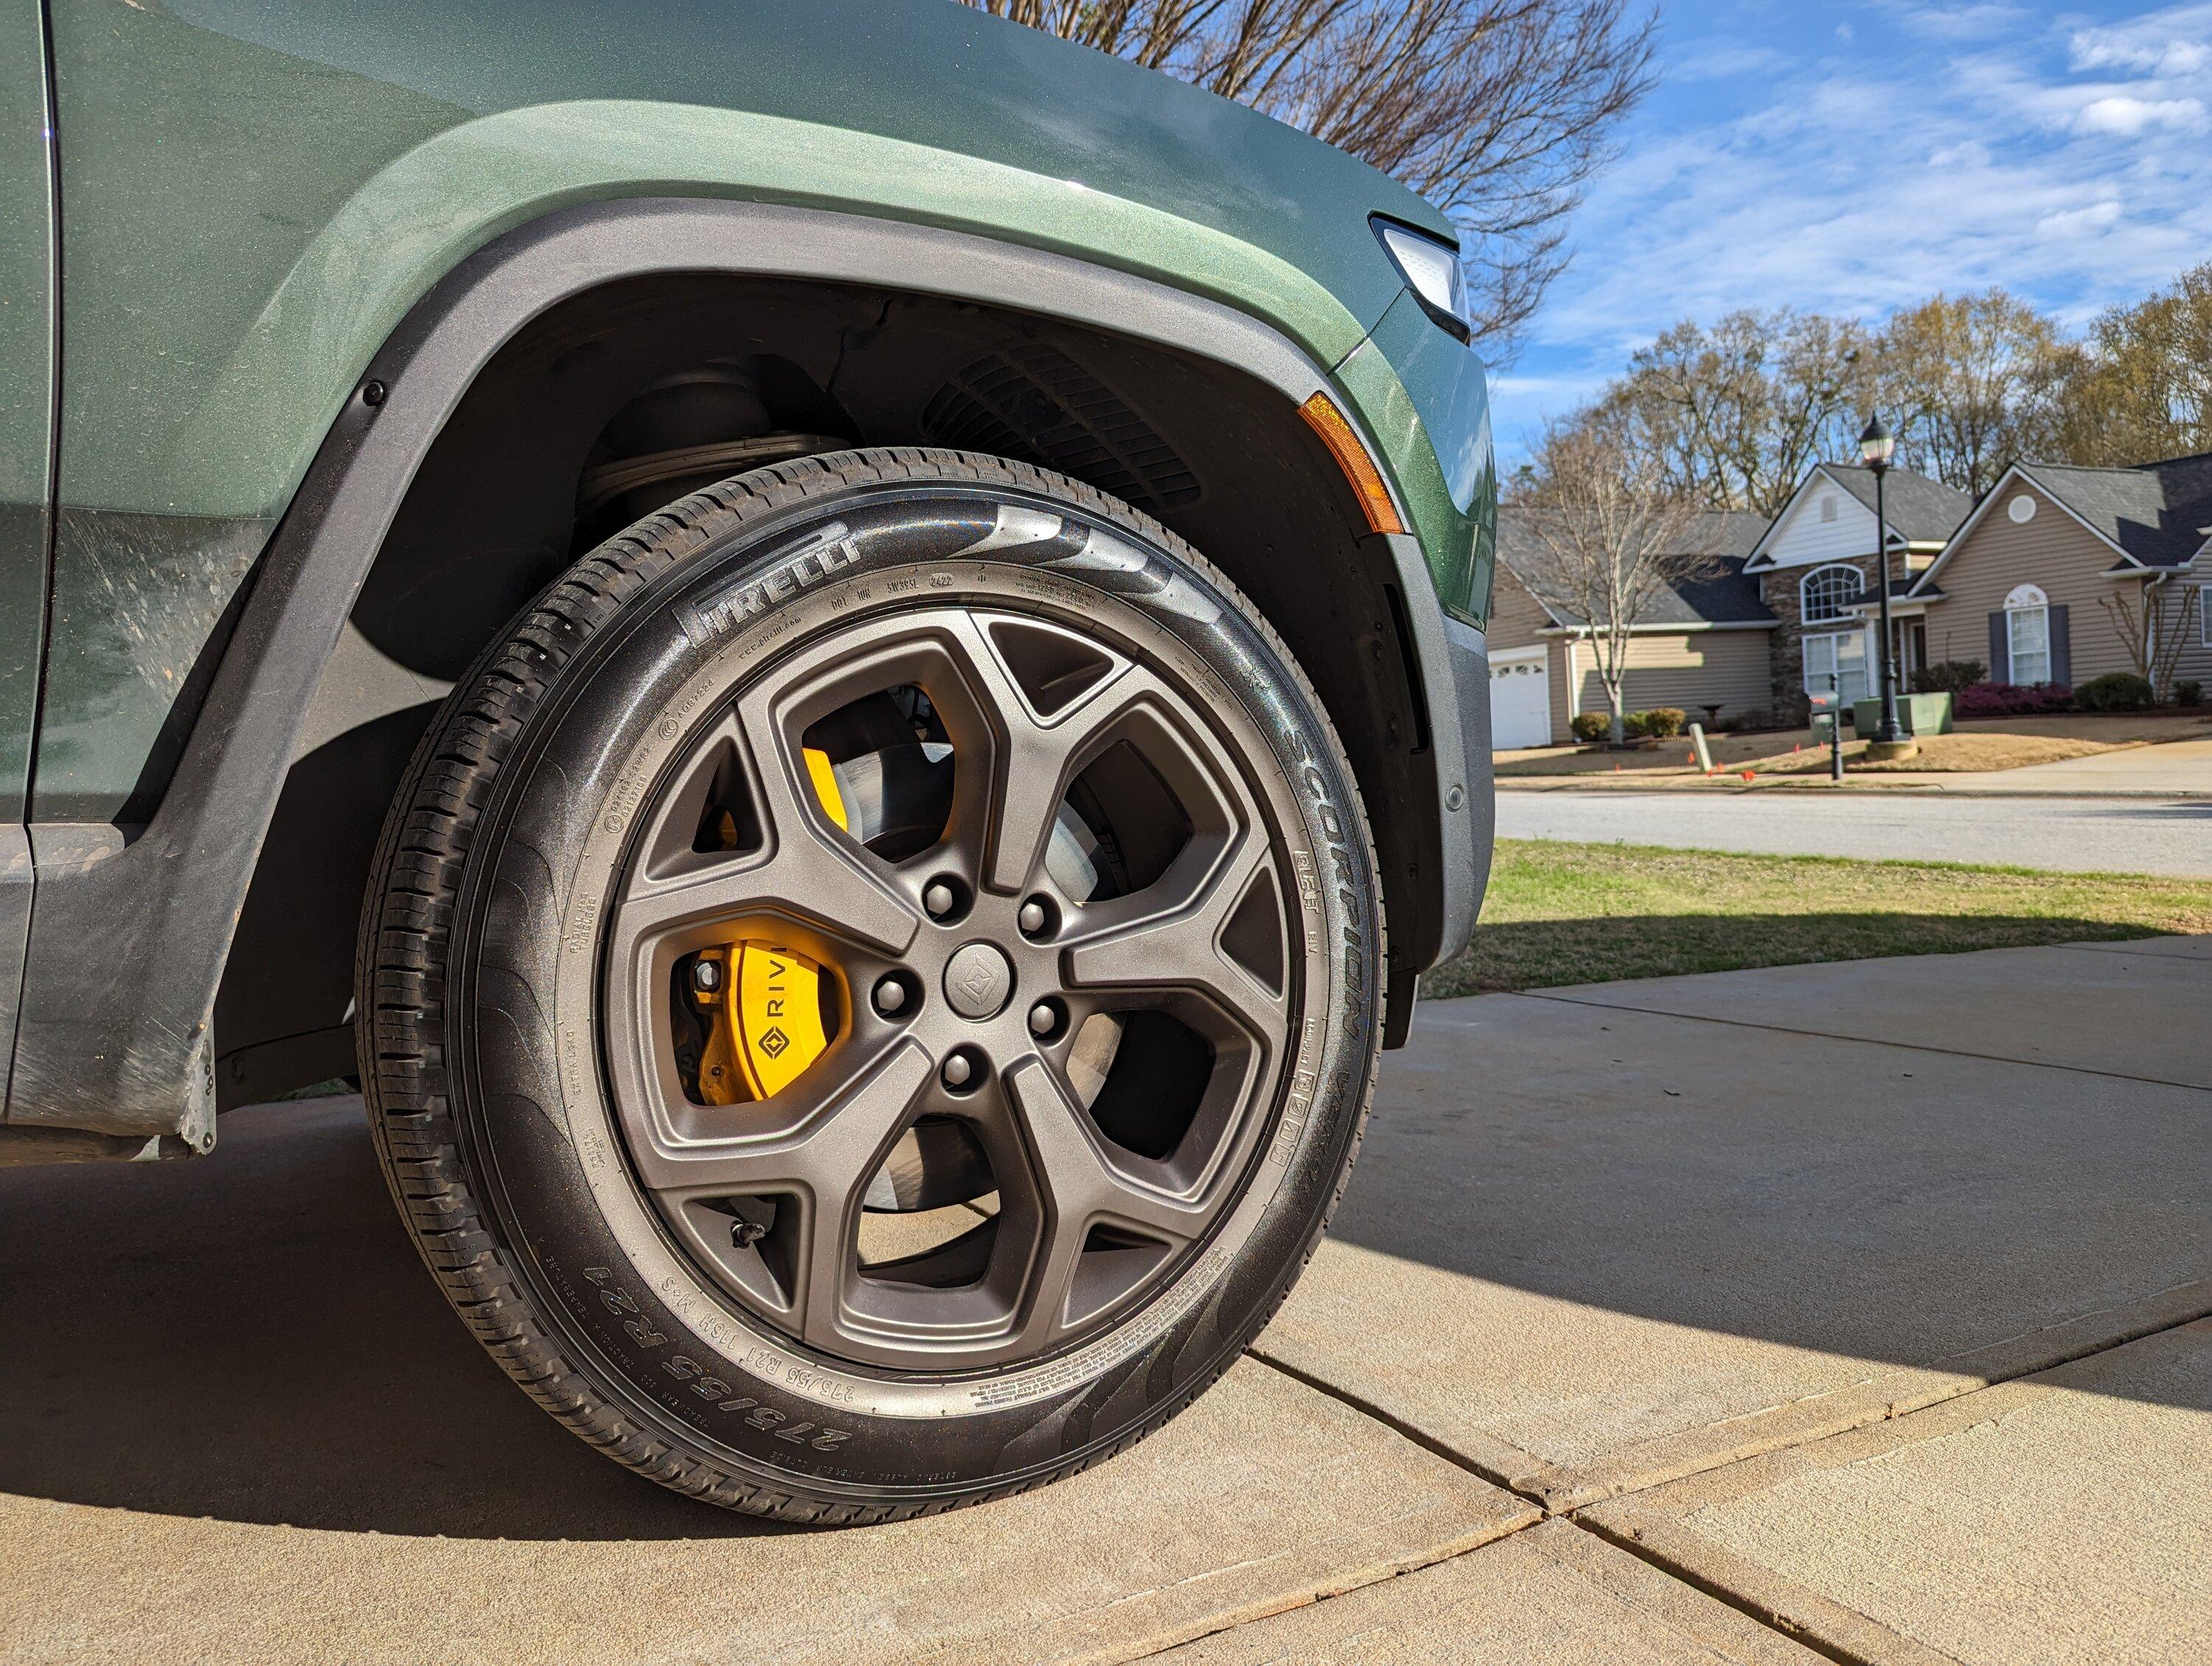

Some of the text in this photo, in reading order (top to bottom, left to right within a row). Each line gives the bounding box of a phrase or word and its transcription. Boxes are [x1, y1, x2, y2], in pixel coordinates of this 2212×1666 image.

[675, 521, 861, 648] PIRELLI
[737, 614, 803, 662] www.pirelli.com
[1284, 729, 1363, 1039] SCORPION
[565, 1029, 583, 1096] EXTRA LOAD
[546, 1254, 589, 1319] TEMPERATURE
[582, 1266, 853, 1451] 275/55 R21
[698, 1311, 739, 1351] 116H
[744, 1344, 783, 1374] R21
[661, 1391, 709, 1427] TREADWEAR
[785, 1366, 855, 1402] 275/55
